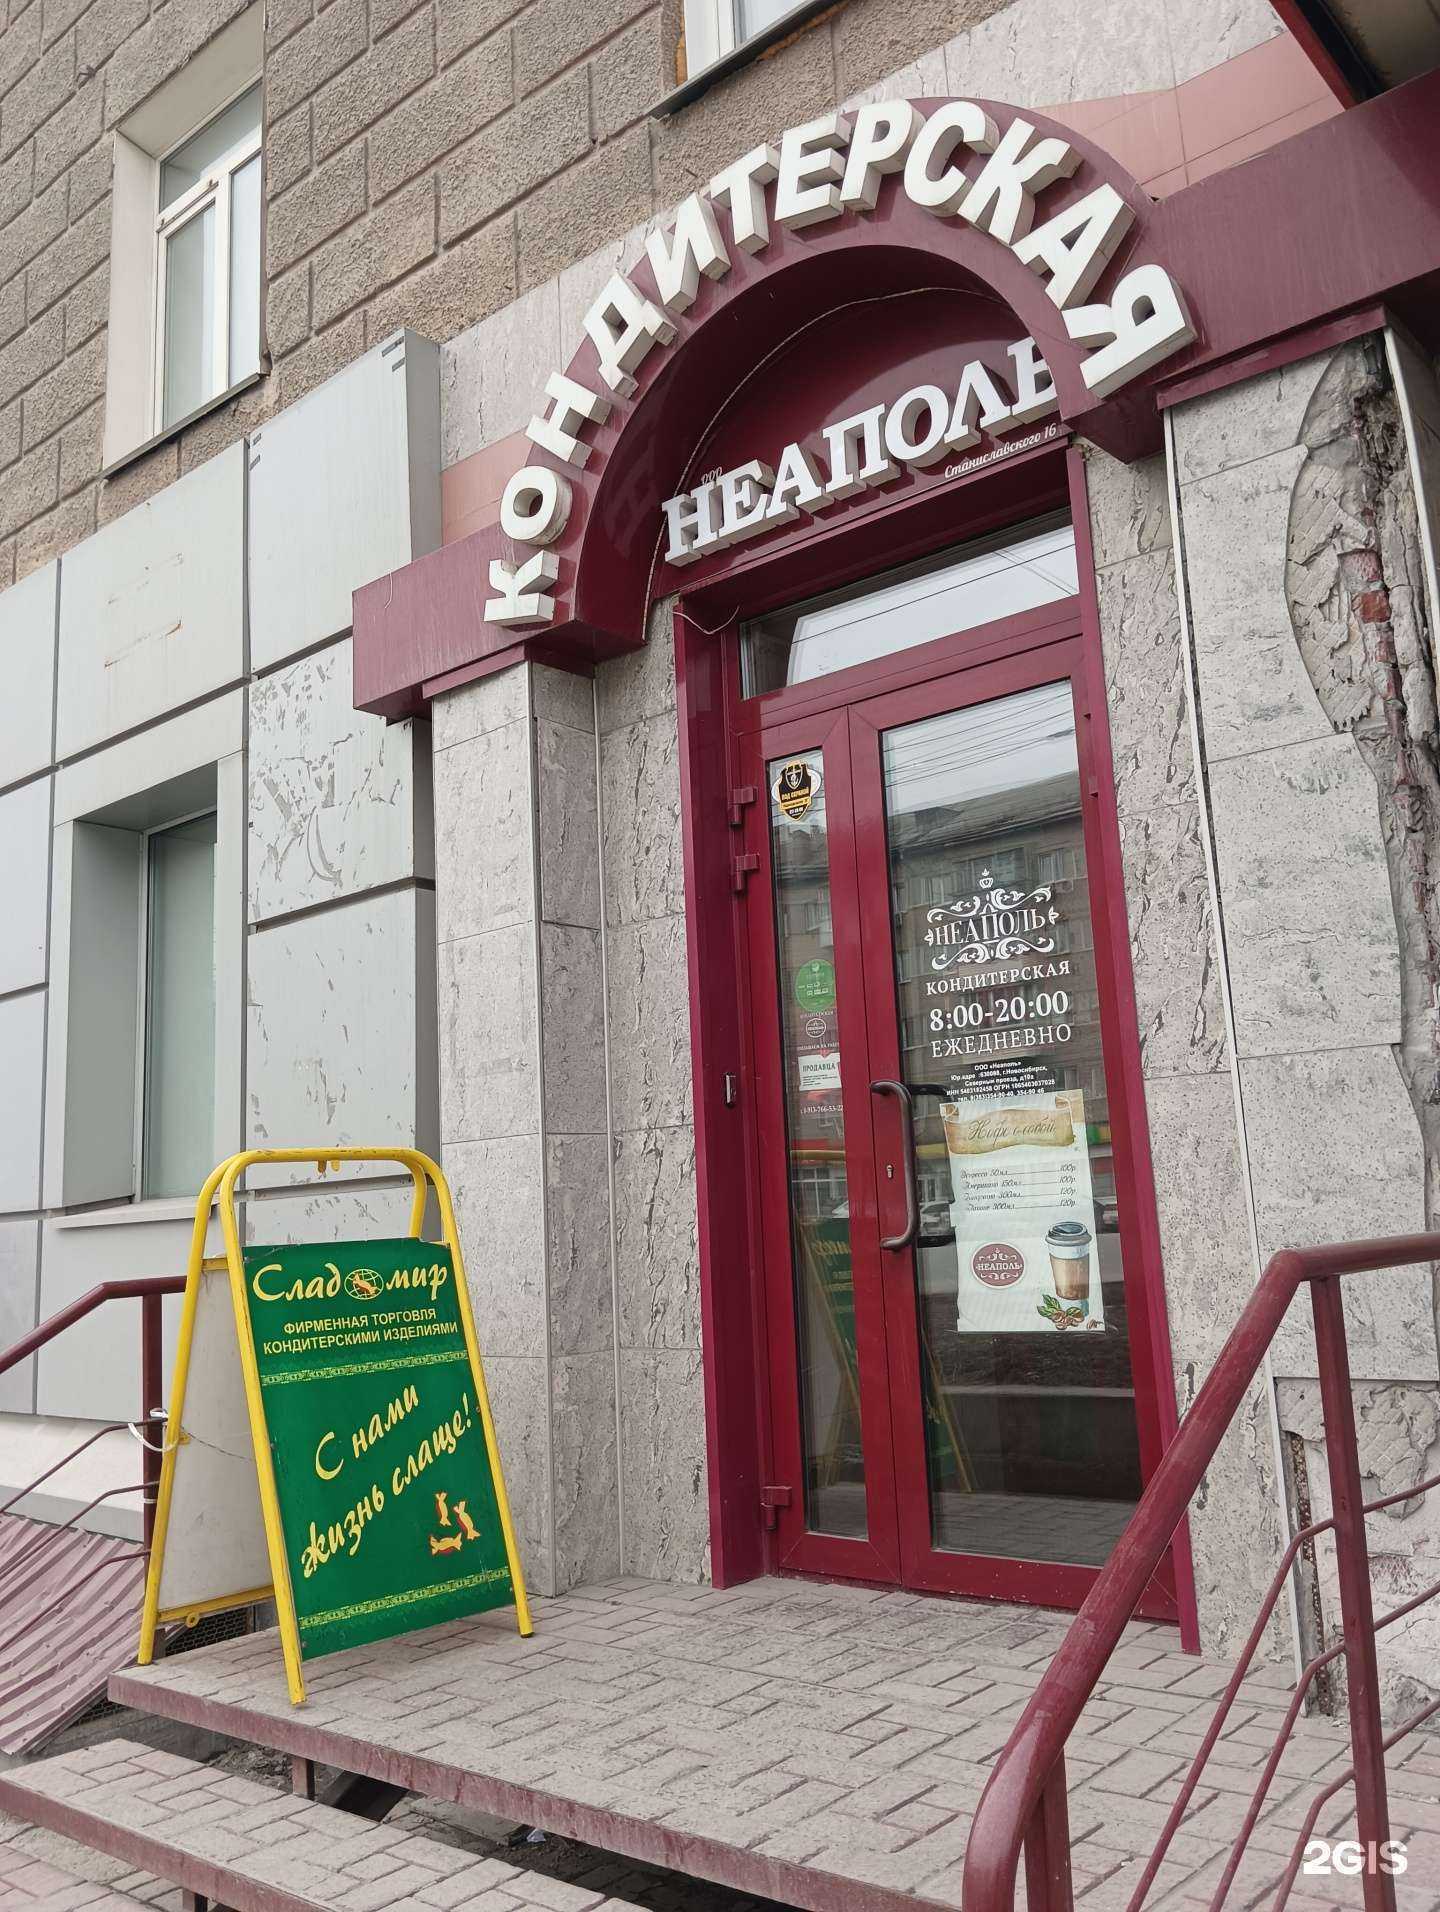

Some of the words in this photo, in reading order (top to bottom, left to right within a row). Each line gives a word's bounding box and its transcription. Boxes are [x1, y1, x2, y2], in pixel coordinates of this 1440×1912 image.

[484, 99, 1197, 626] КОНДИТЕРСКАЯ
[661, 336, 1059, 567] НЕАПОЛЬ
[944, 432, 1041, 478] Станиславского
[1044, 422, 1057, 439] 16
[935, 907, 1046, 946] НЕАПОЛЬ
[926, 960, 1071, 996] КОНДИТЕРСКАЯ
[929, 990, 1069, 1032] 8:00-20:00
[931, 1023, 1072, 1059] ЕЖЕДНЕВНО
[802, 1062, 836, 1073] ПРОДАВЦА
[993, 1083, 1010, 1091] ОГРН
[977, 1261, 1021, 1271] НЕАПОЛЬ
[263, 1331, 381, 1354] КОНДИТЕРСКИМИ
[383, 1321, 458, 1342] ИЗДЕЛИЯМИ
[283, 1314, 369, 1335] ФИРМЕННАЯ
[370, 1308, 437, 1326] ТОРГОВЛЯ
[315, 1431, 344, 1480] С
[352, 1385, 420, 1459] нами
[301, 1484, 386, 1579] жизнь
[392, 1392, 473, 1498] слаще!
